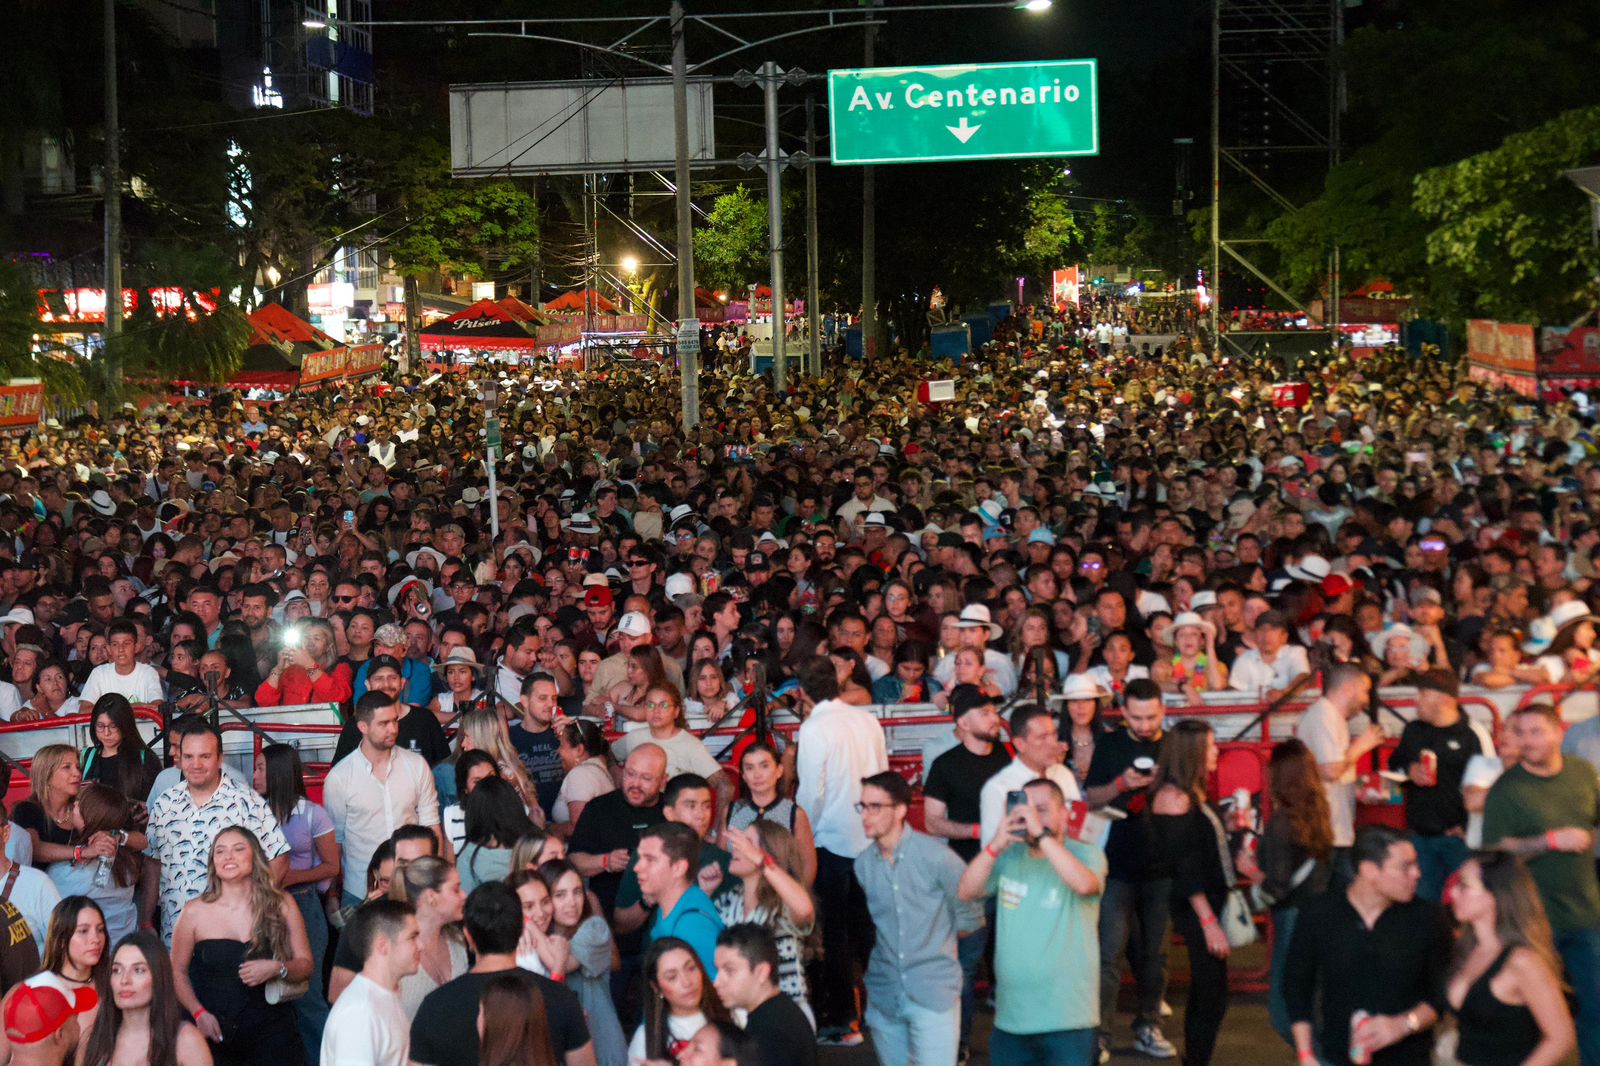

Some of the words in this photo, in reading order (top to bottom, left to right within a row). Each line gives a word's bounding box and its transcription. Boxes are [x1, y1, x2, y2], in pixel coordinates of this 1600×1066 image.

[848, 85, 895, 112] Av.
[905, 78, 1080, 109] Centenario
[452, 318, 501, 330] Pilsen
